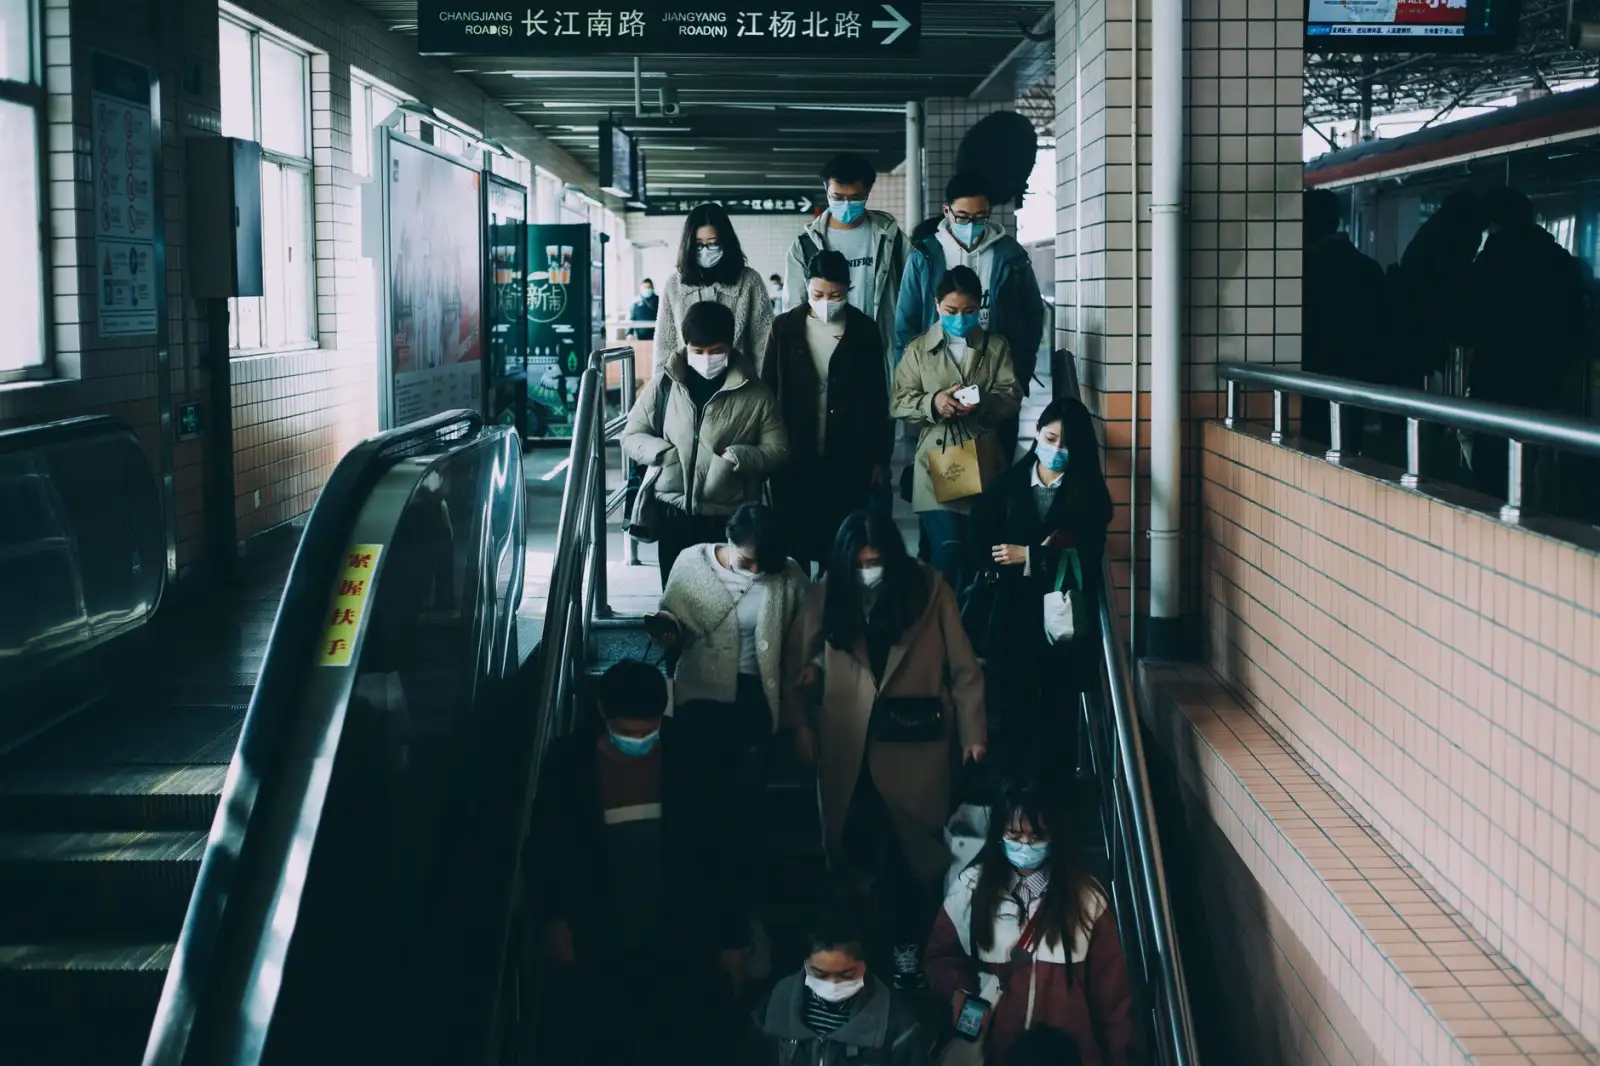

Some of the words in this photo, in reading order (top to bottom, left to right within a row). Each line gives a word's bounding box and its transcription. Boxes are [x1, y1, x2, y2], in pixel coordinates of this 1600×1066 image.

[439, 11, 513, 22] CHANGJIANG
[520, 8, 647, 38] 长江南路
[662, 11, 727, 23] JIANGYANG
[465, 24, 513, 37] ROAD(S)
[736, 10, 863, 39] 江杨北路
[678, 25, 728, 38] ROAD(N)
[326, 551, 373, 656] 紧握扶手
